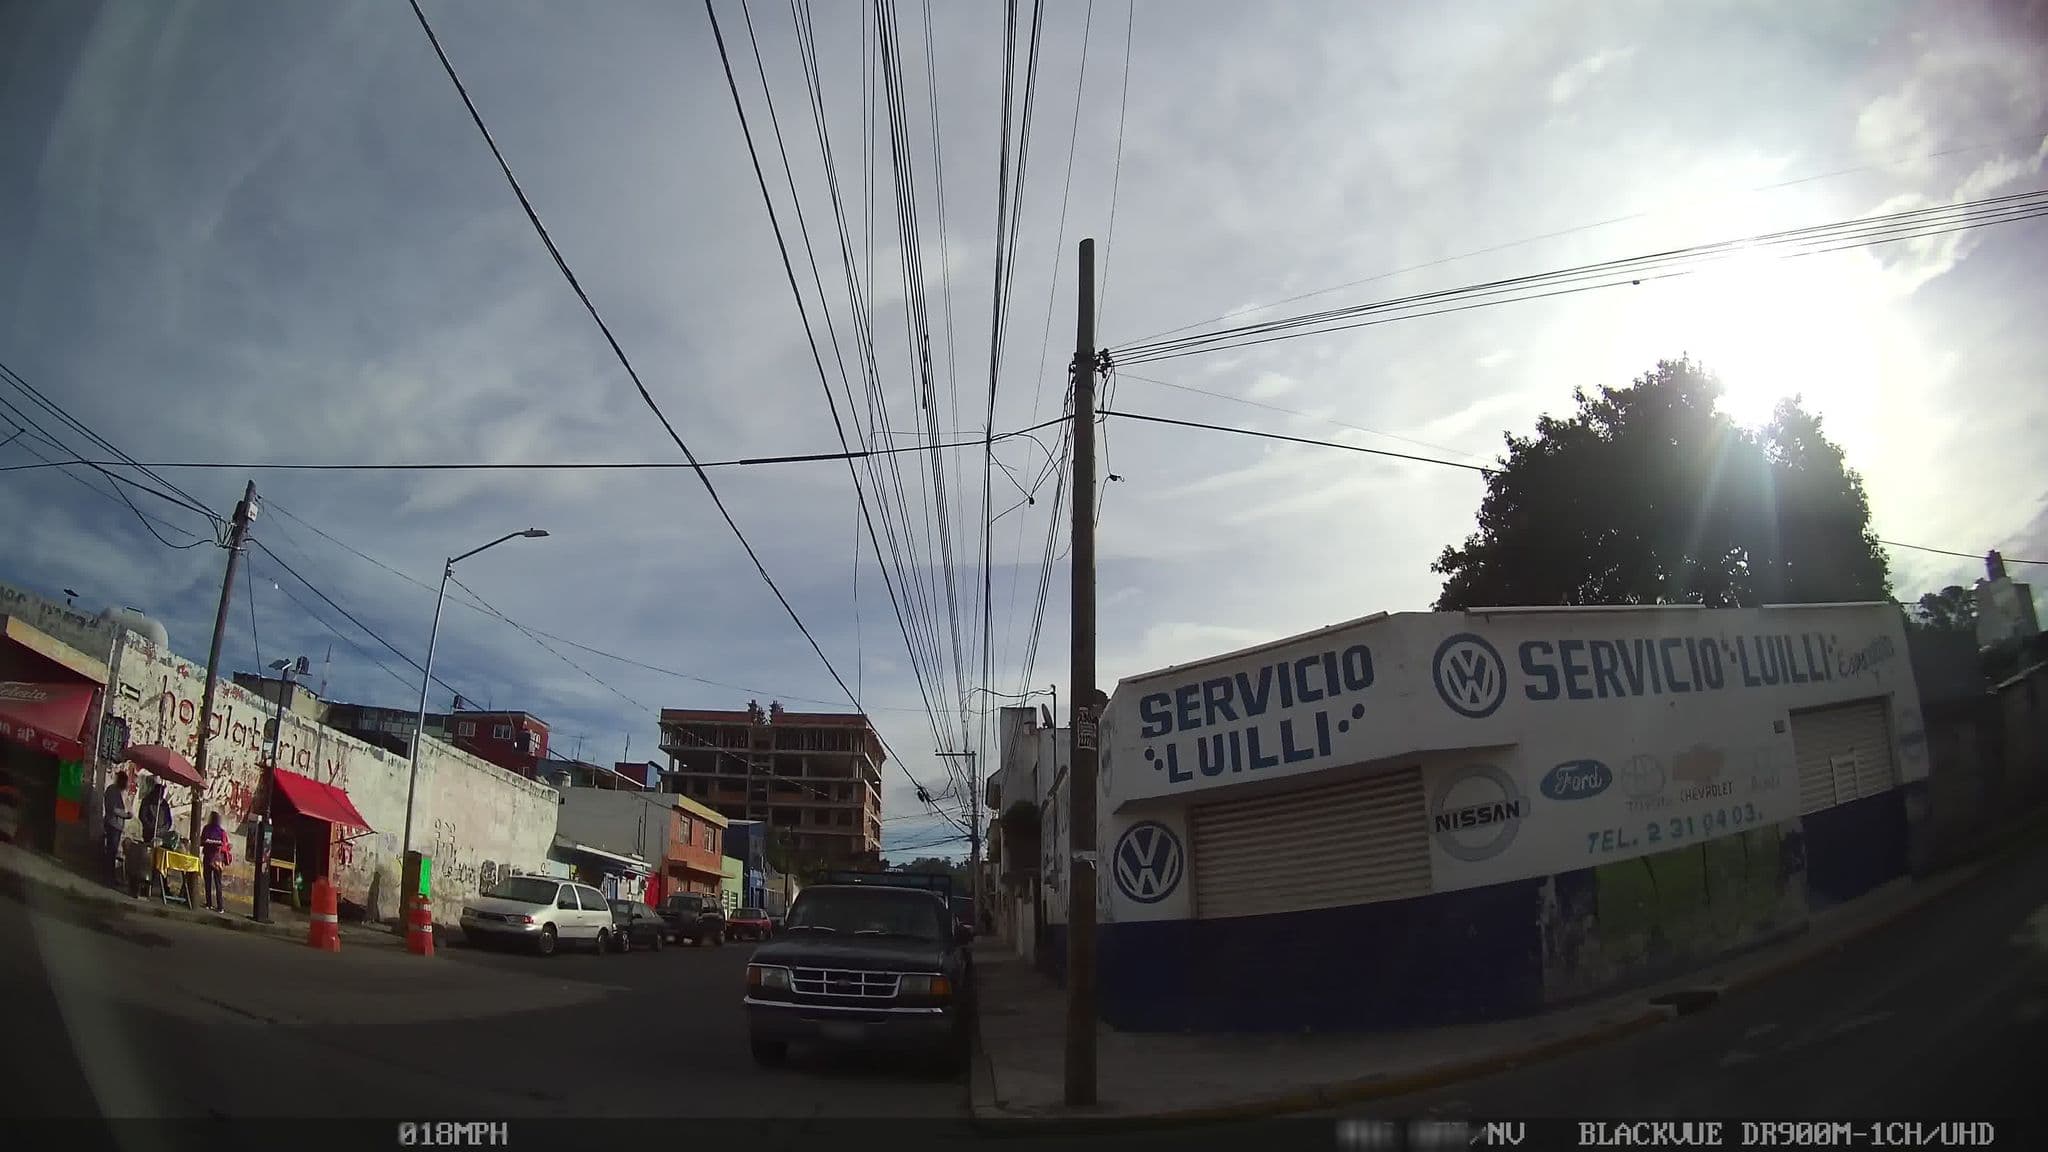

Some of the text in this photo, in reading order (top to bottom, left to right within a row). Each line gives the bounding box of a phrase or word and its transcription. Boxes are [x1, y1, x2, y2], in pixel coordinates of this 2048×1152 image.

[1518, 637, 1724, 701] SERVICIO
[1736, 632, 1832, 688] LUILLI
[1139, 644, 1374, 739] SERVICIO
[1167, 711, 1331, 783] LUILLI
[1553, 763, 1603, 795] Ford
[1680, 780, 1735, 803] CHEVROLET
[1435, 799, 1520, 833] NISSAN
[1586, 824, 1639, 854] TEL.
